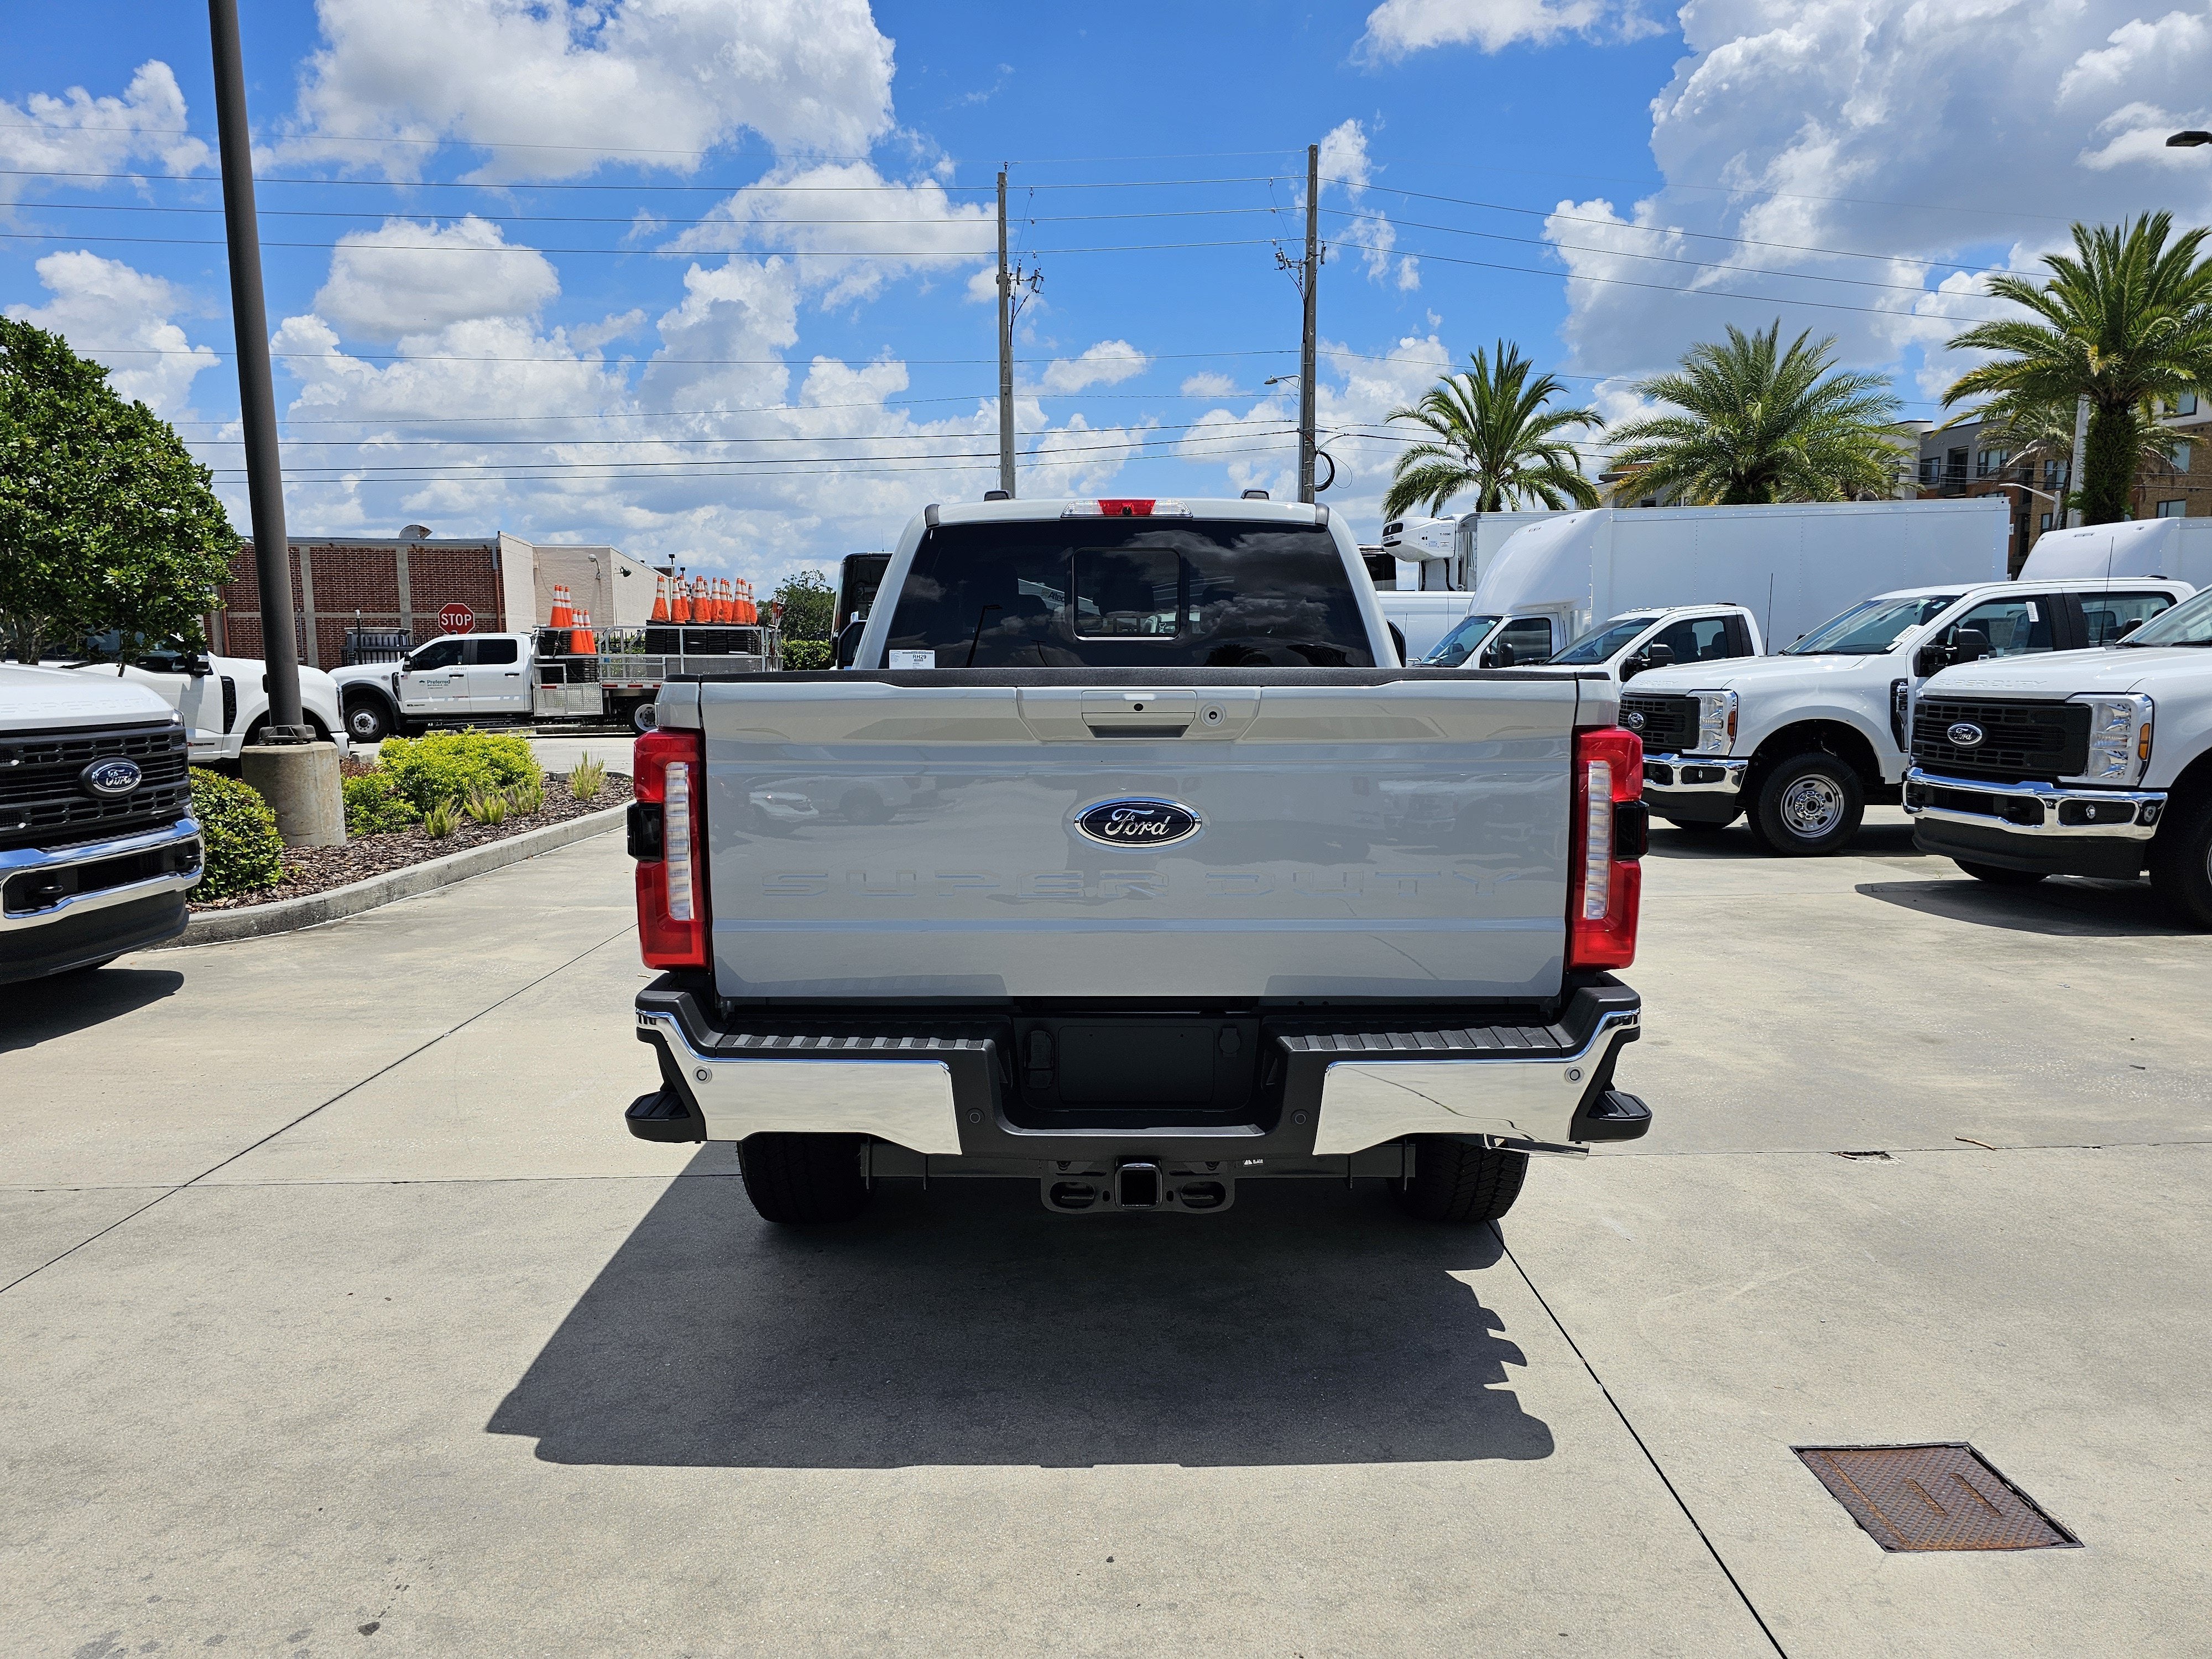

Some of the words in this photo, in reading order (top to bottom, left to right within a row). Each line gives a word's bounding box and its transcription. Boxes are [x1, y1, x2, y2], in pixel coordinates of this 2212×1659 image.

[441, 613, 472, 626] STOP
[1954, 727, 1973, 741] Ford
[106, 769, 132, 786] Ford
[1104, 808, 1171, 836] Ford
[763, 869, 1170, 898] SUPER
[1205, 869, 1521, 897] DUTY
